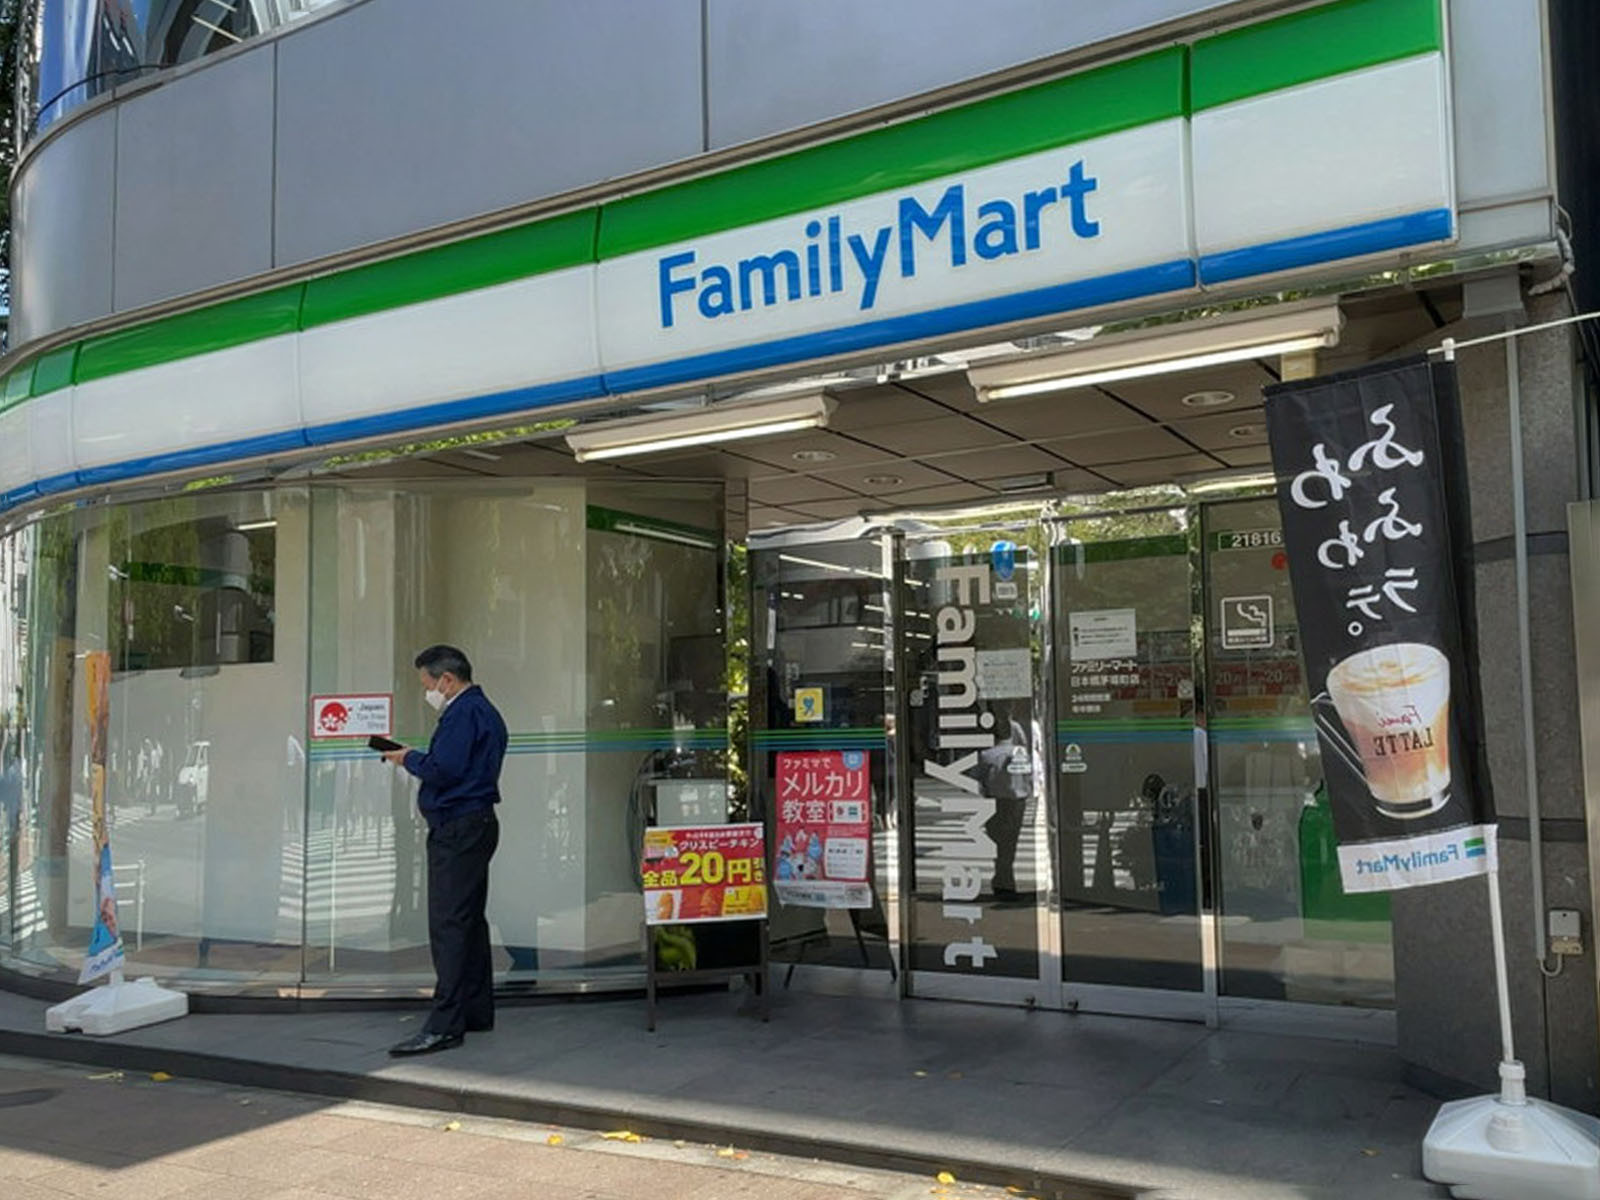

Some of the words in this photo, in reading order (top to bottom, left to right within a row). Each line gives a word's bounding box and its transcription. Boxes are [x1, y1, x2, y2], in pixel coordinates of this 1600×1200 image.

[658, 160, 1100, 329] FamilyMart
[1231, 532, 1282, 548] 21816
[1071, 660, 1138, 673] ファミリーマート
[783, 758, 832, 769] ファミマで
[923, 564, 998, 968] FamilyMart
[782, 771, 863, 798] メルカリ
[782, 799, 826, 824] 教室
